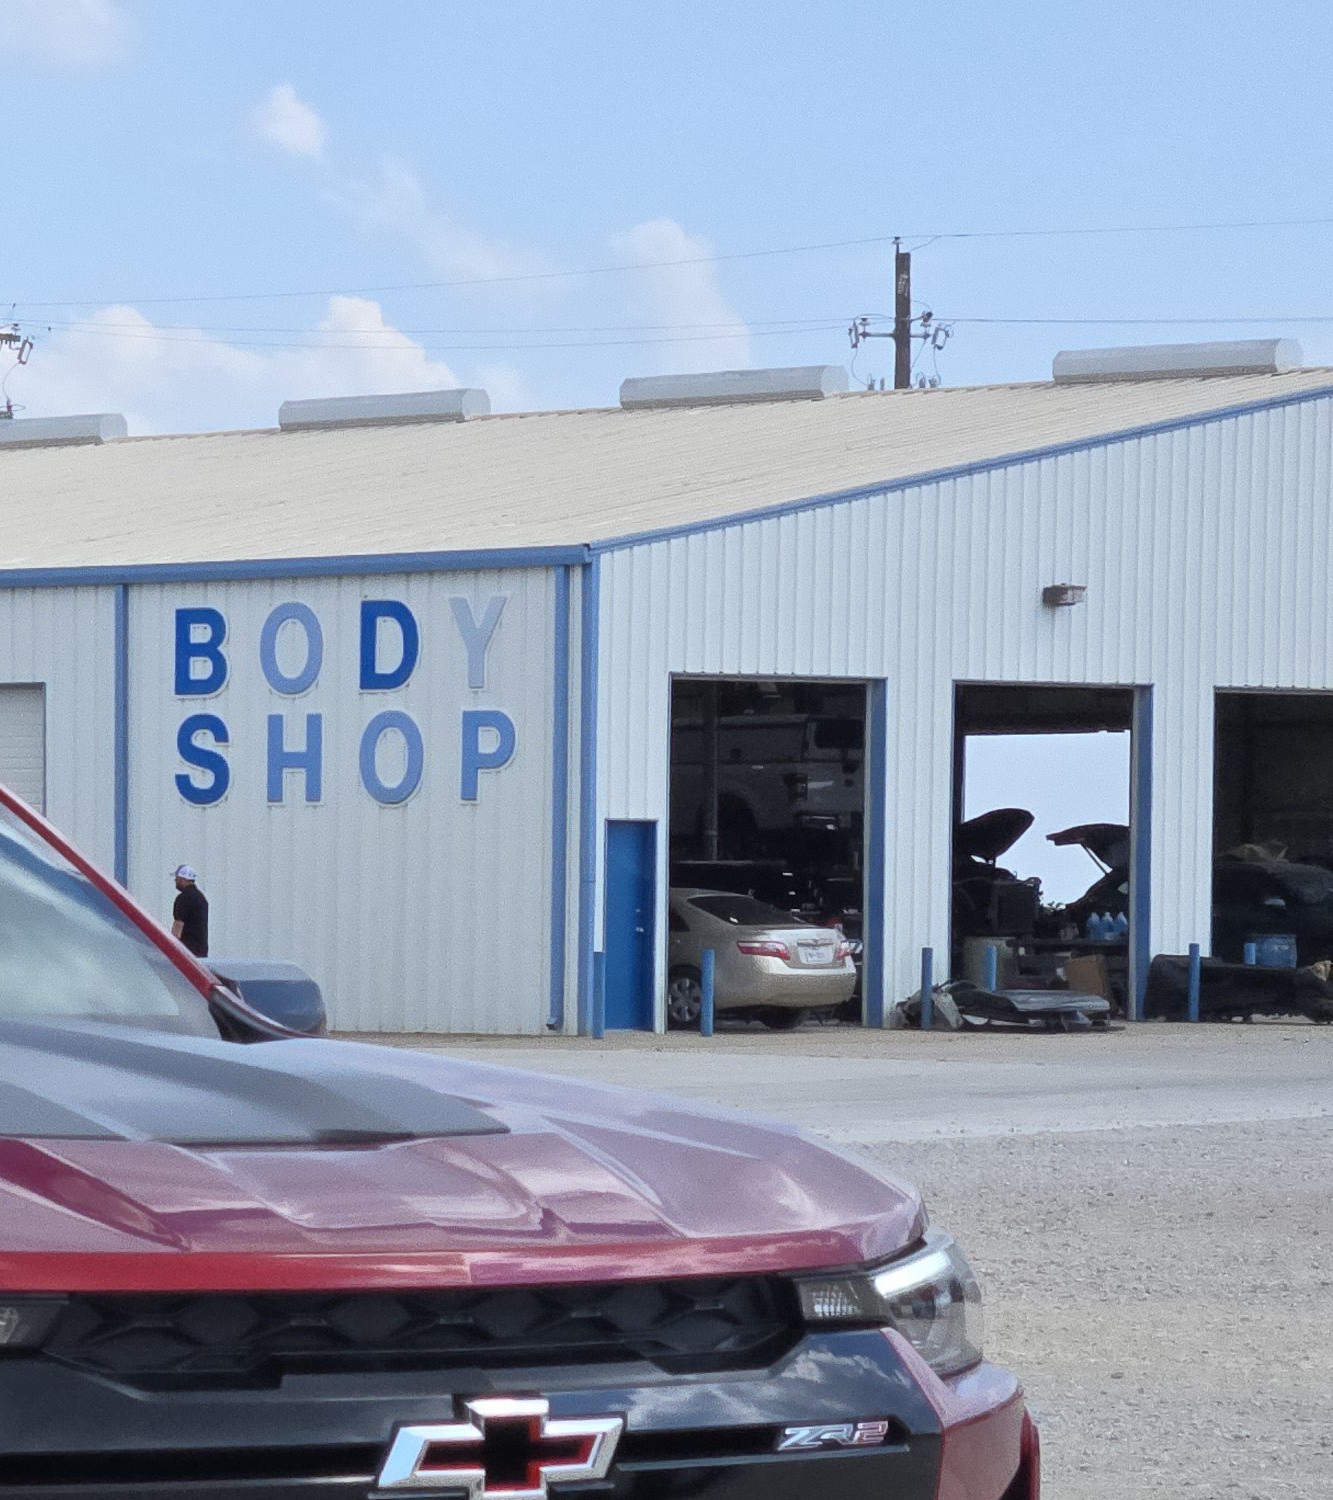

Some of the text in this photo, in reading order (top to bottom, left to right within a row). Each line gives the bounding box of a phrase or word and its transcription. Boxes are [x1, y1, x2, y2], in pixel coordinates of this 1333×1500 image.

[174, 597, 507, 696] BODY
[175, 711, 516, 804] SHOP
[778, 1420, 888, 1450] ZR2
